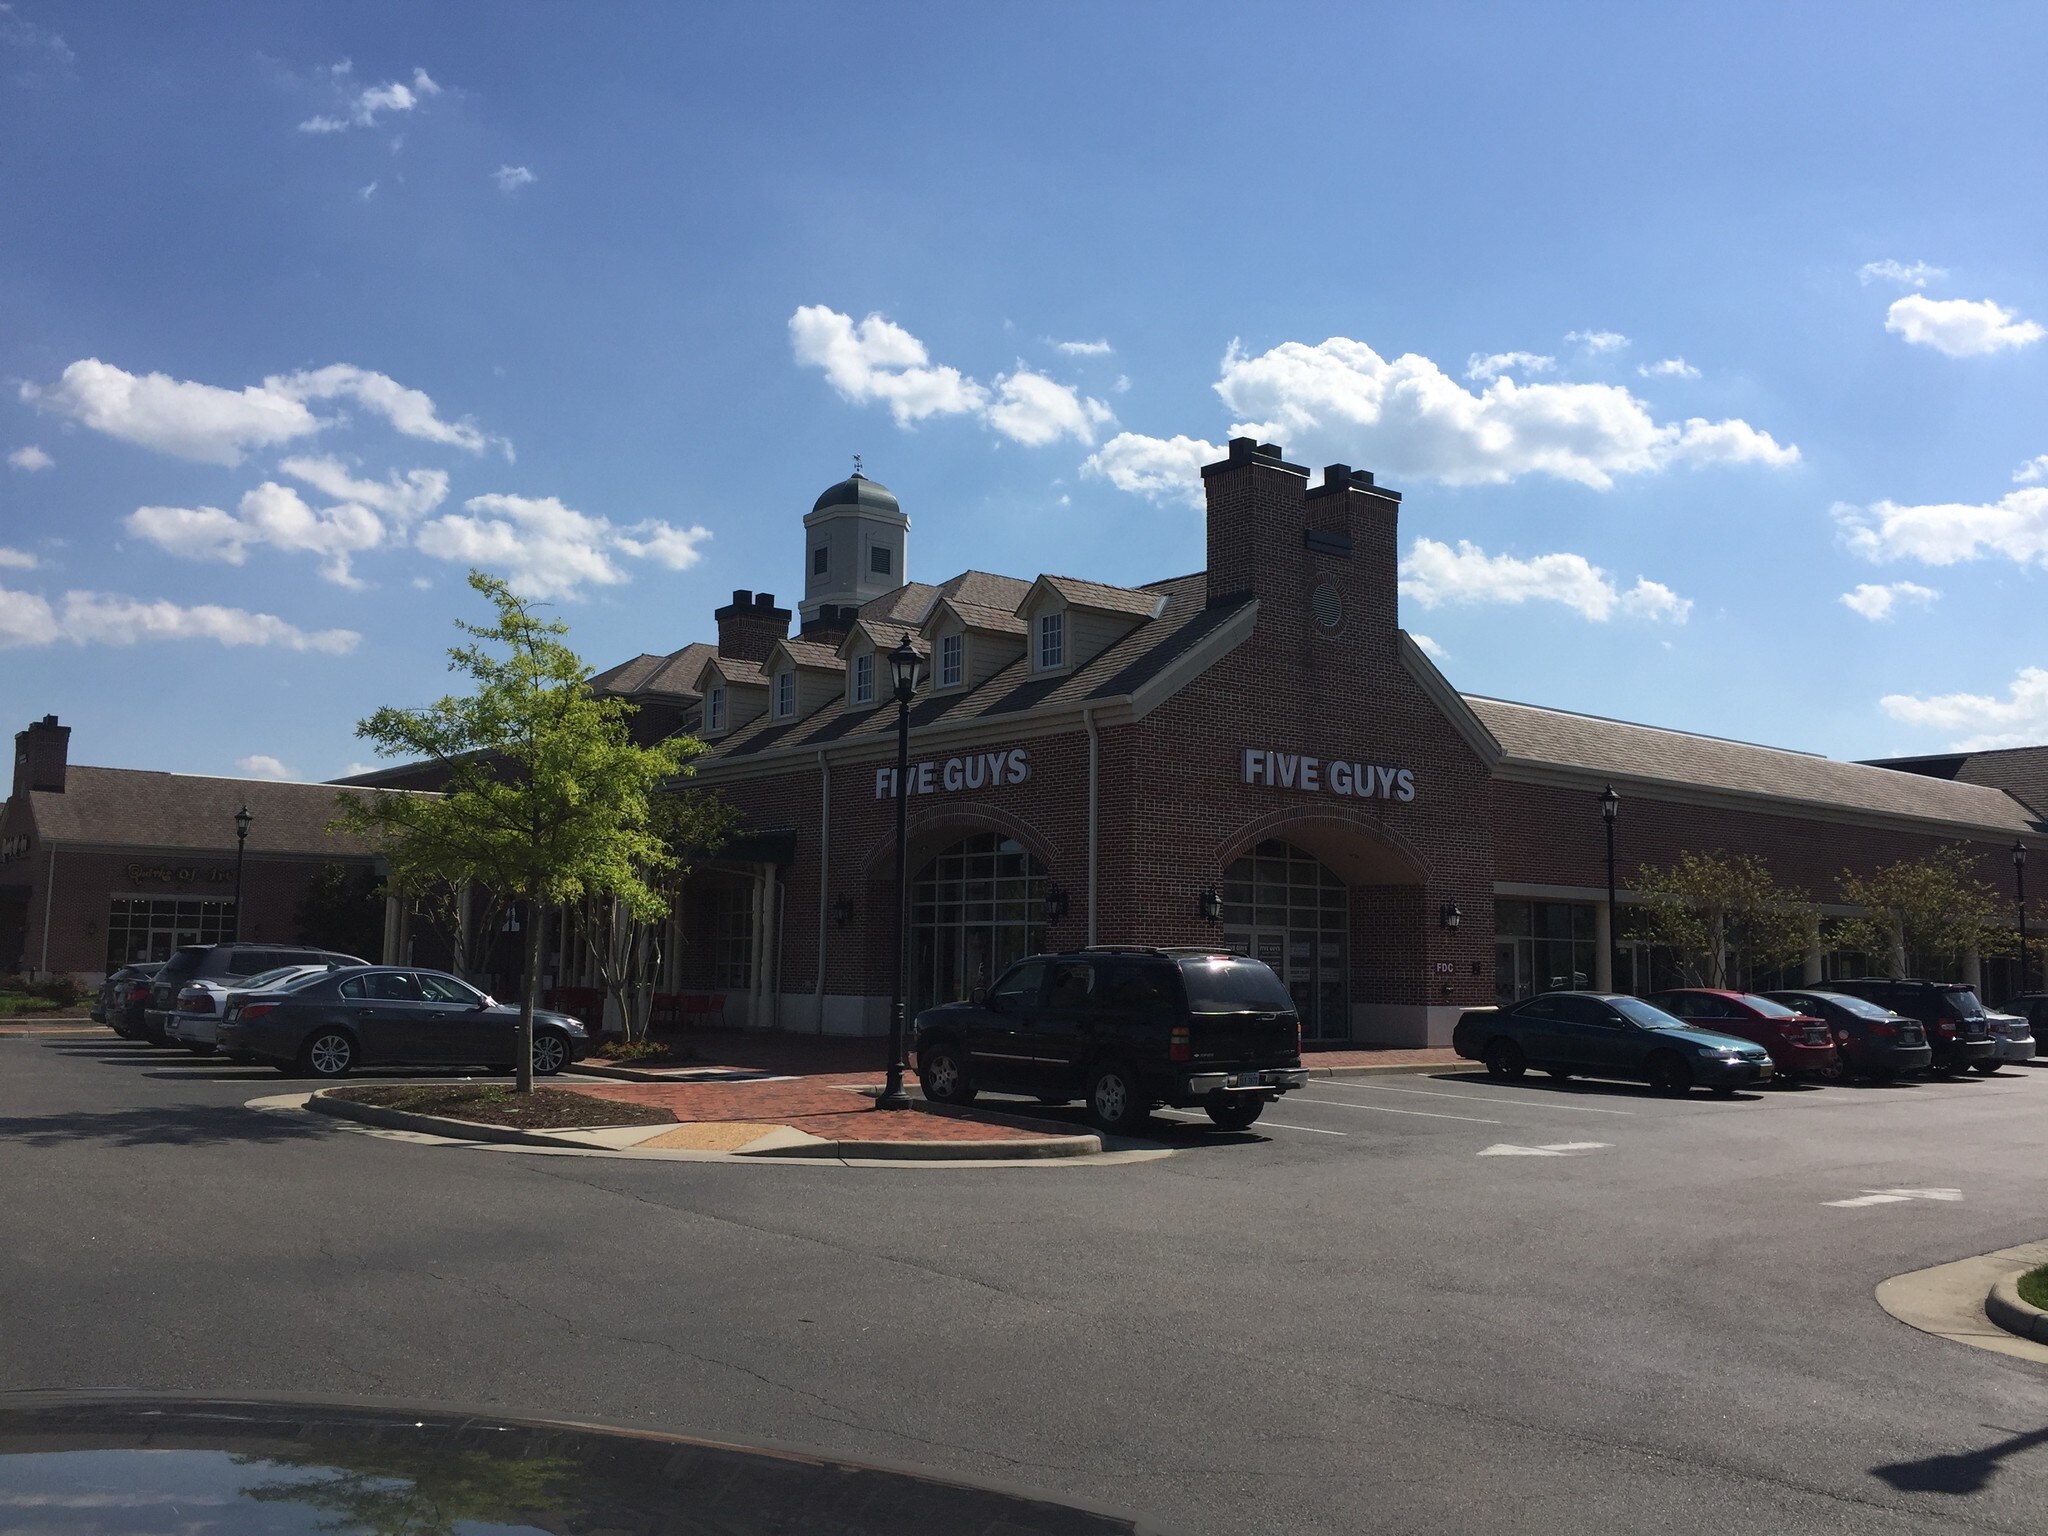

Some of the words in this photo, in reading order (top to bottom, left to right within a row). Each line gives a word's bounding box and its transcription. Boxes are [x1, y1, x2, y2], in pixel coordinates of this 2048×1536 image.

[875, 761, 935, 800] FIVE
[943, 748, 1029, 792] GUYS
[1243, 748, 1320, 791] FIVE
[1328, 760, 1416, 802] GUYS
[1436, 962, 1454, 973] FDC
